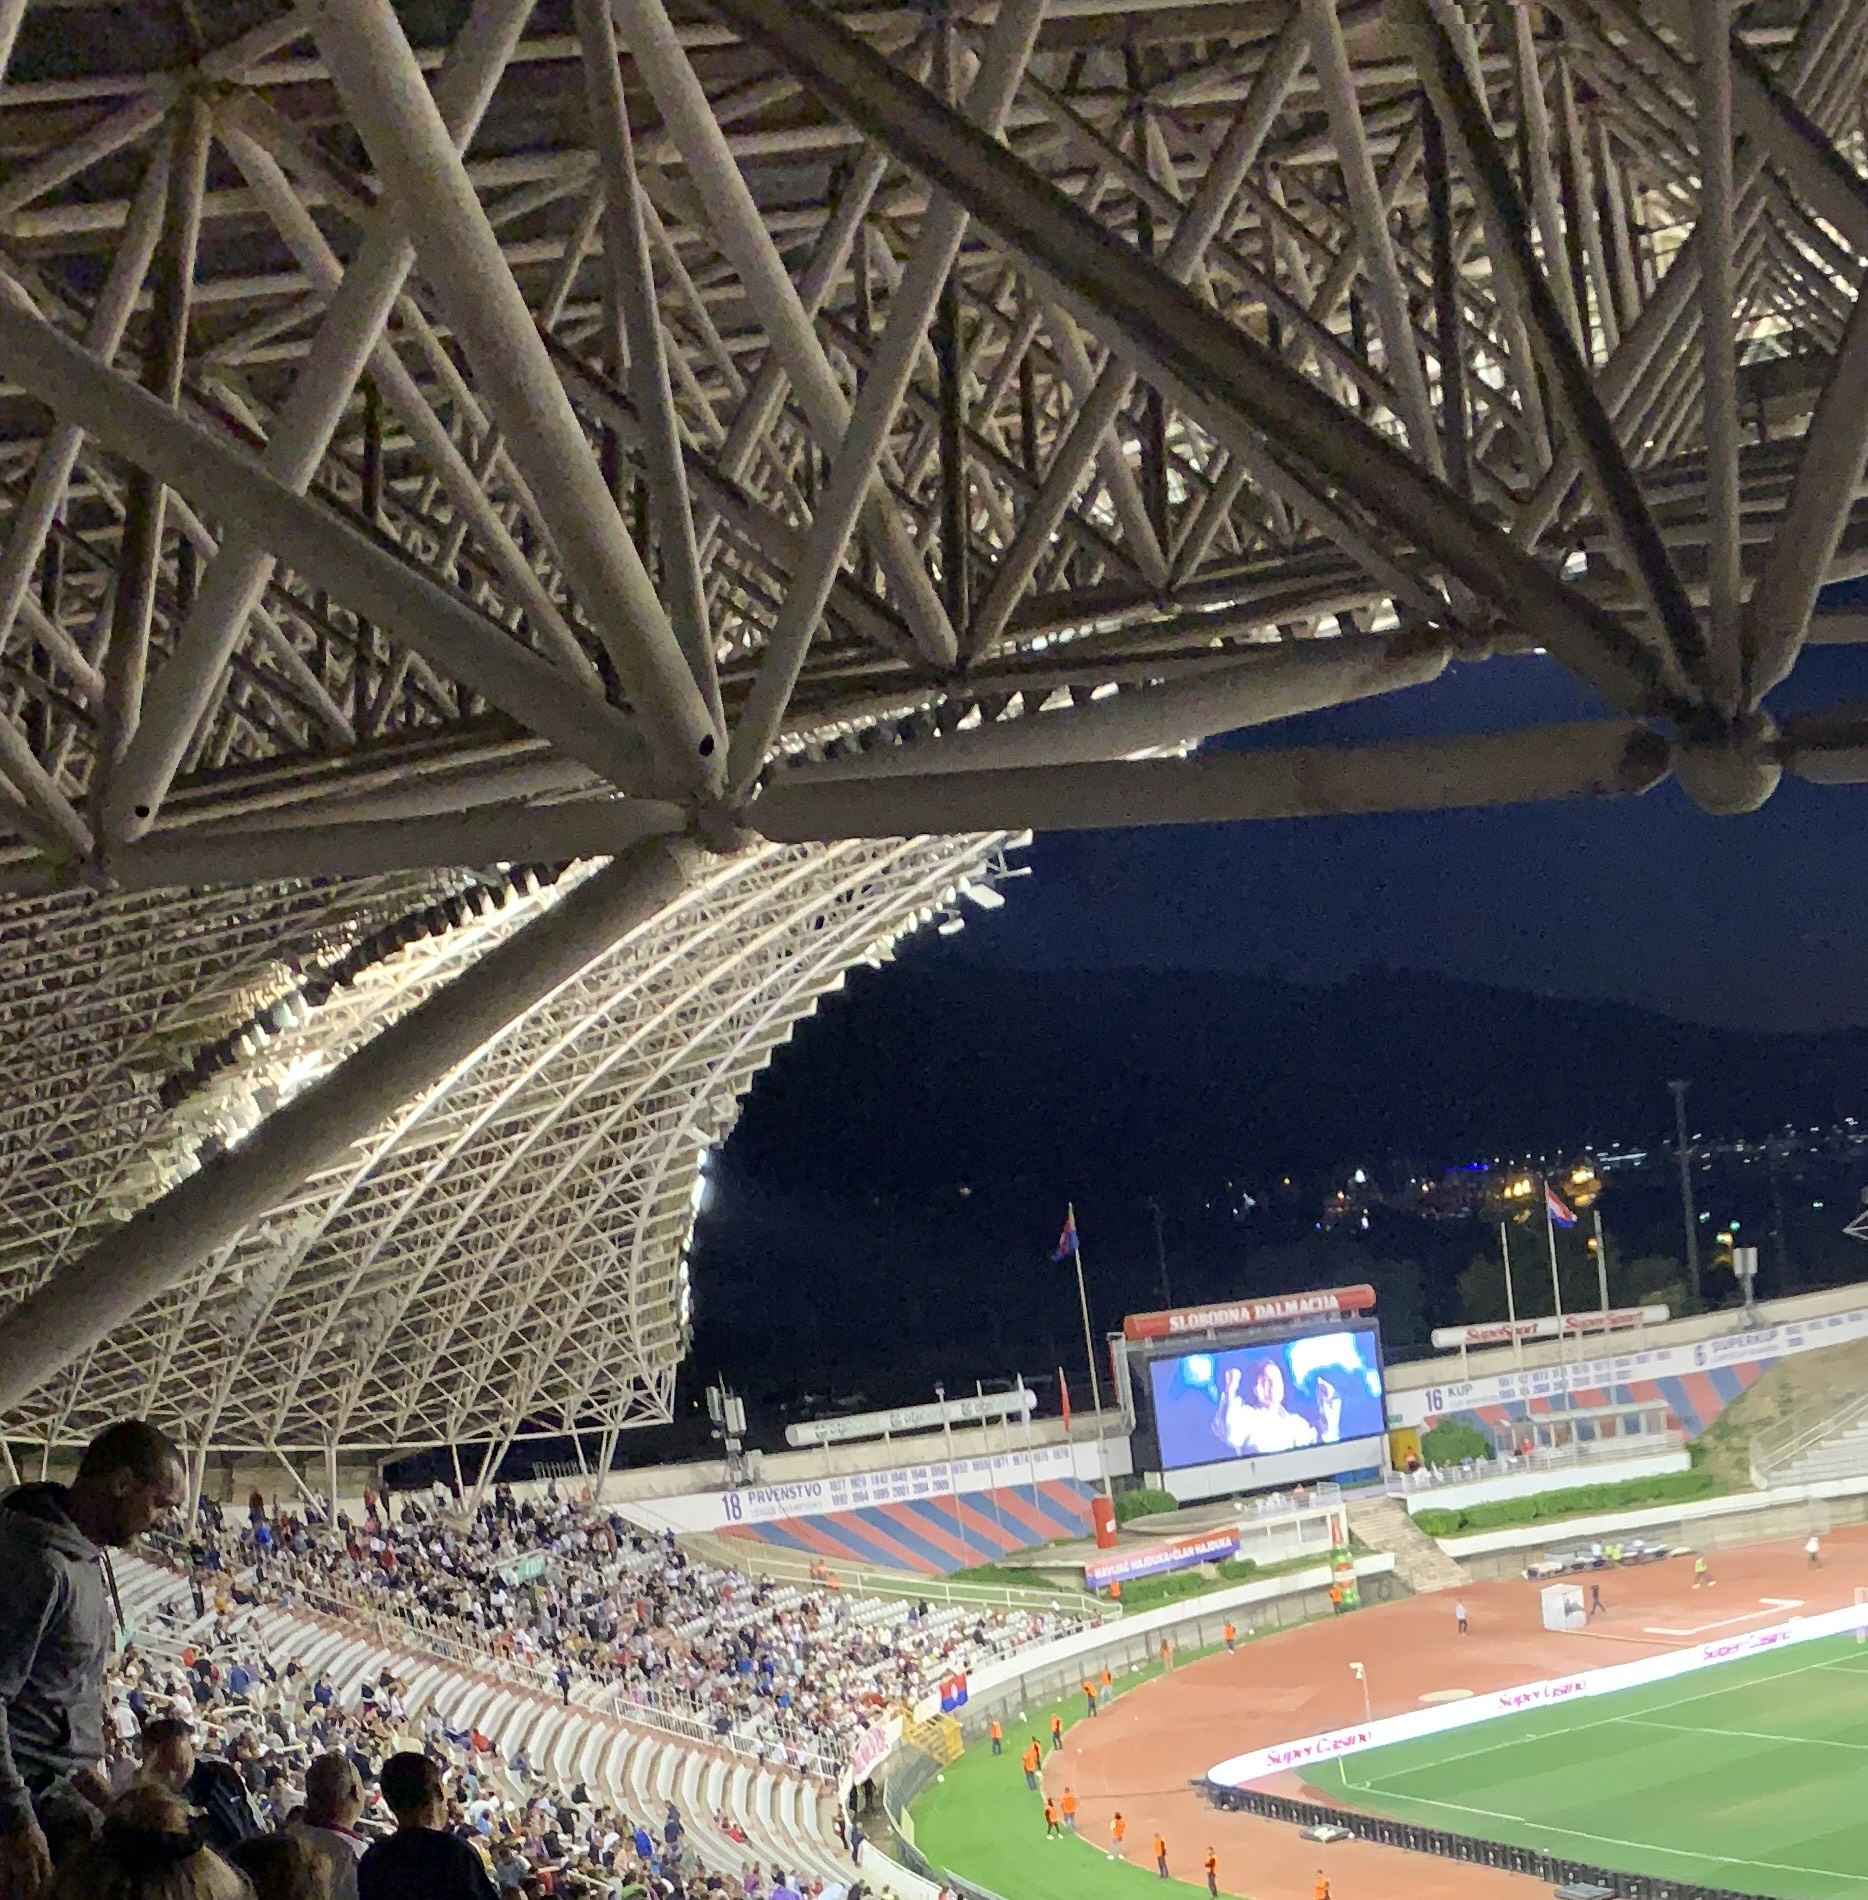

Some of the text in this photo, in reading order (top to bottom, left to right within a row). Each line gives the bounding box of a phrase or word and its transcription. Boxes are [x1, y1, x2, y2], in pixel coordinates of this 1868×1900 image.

[1169, 1294, 1340, 1332] SLOBODNA DALMACIJA
[1424, 1388, 1444, 1412] 16
[1447, 1383, 1473, 1398] KUP
[721, 1482, 822, 1522] 18 PRVENSTVO
[1195, 1536, 1233, 1556] HAJDUKA
[1499, 1679, 1587, 1709] Super Casino
[1267, 1731, 1372, 1767] Super Casino
